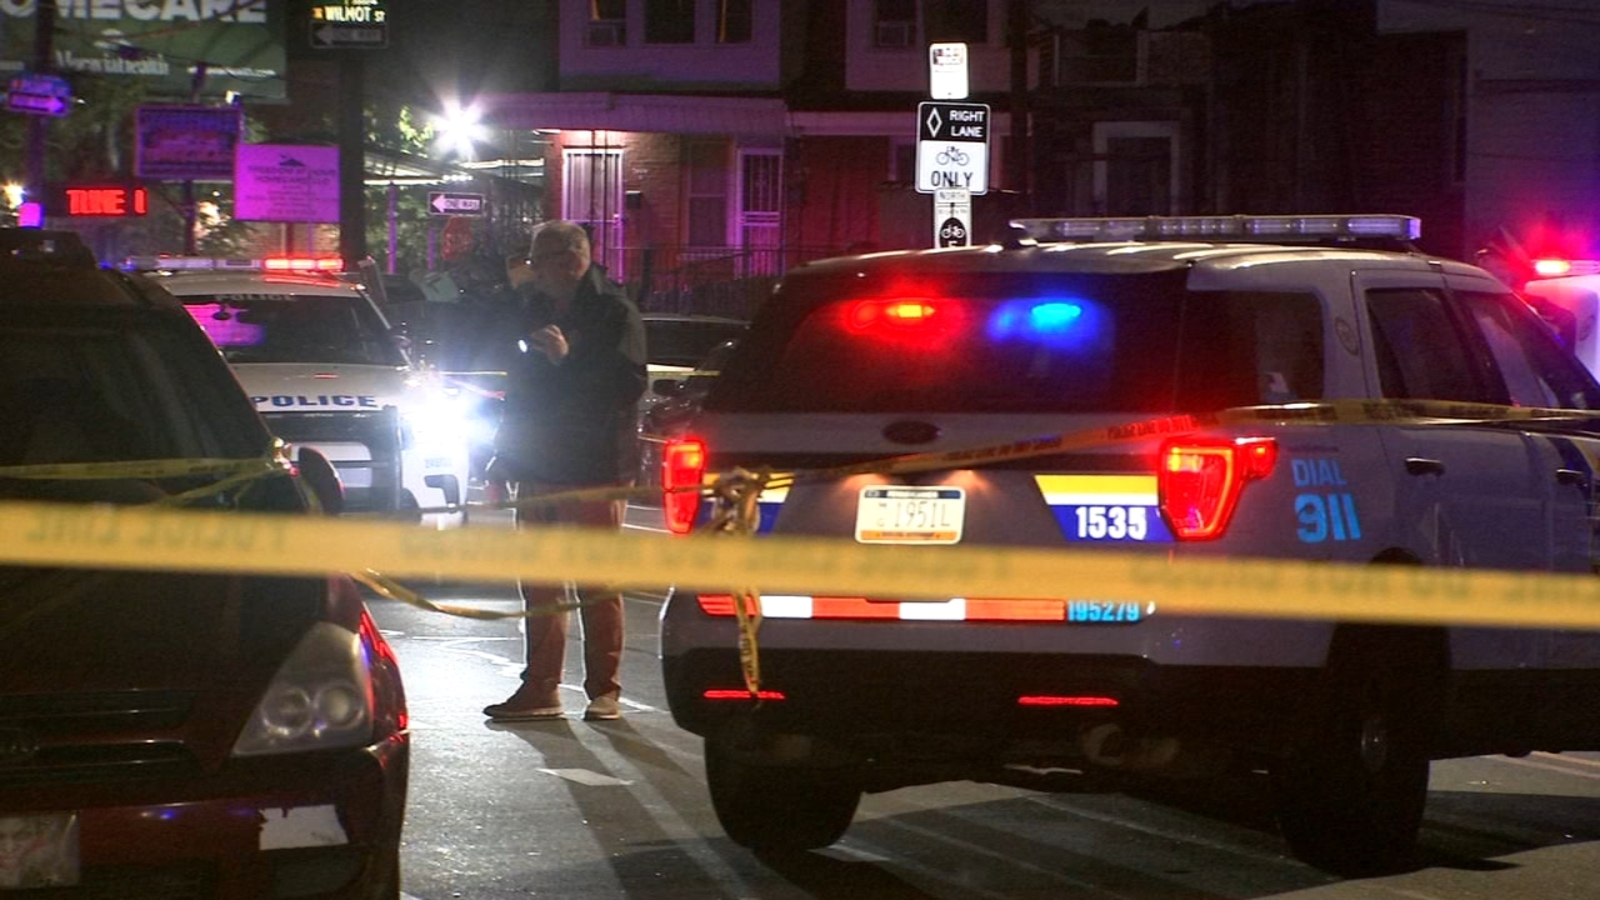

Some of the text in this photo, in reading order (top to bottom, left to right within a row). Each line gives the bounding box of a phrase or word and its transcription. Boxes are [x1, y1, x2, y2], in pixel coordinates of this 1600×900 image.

[324, 6, 372, 21] WILMOT
[949, 110, 985, 123] RIGHT
[951, 126, 984, 137] LANE
[930, 170, 974, 187] ONLY
[250, 395, 378, 407] POLICE
[1291, 459, 1347, 488] DIAL
[1075, 506, 1148, 540] 1535
[1294, 492, 1361, 542] 911
